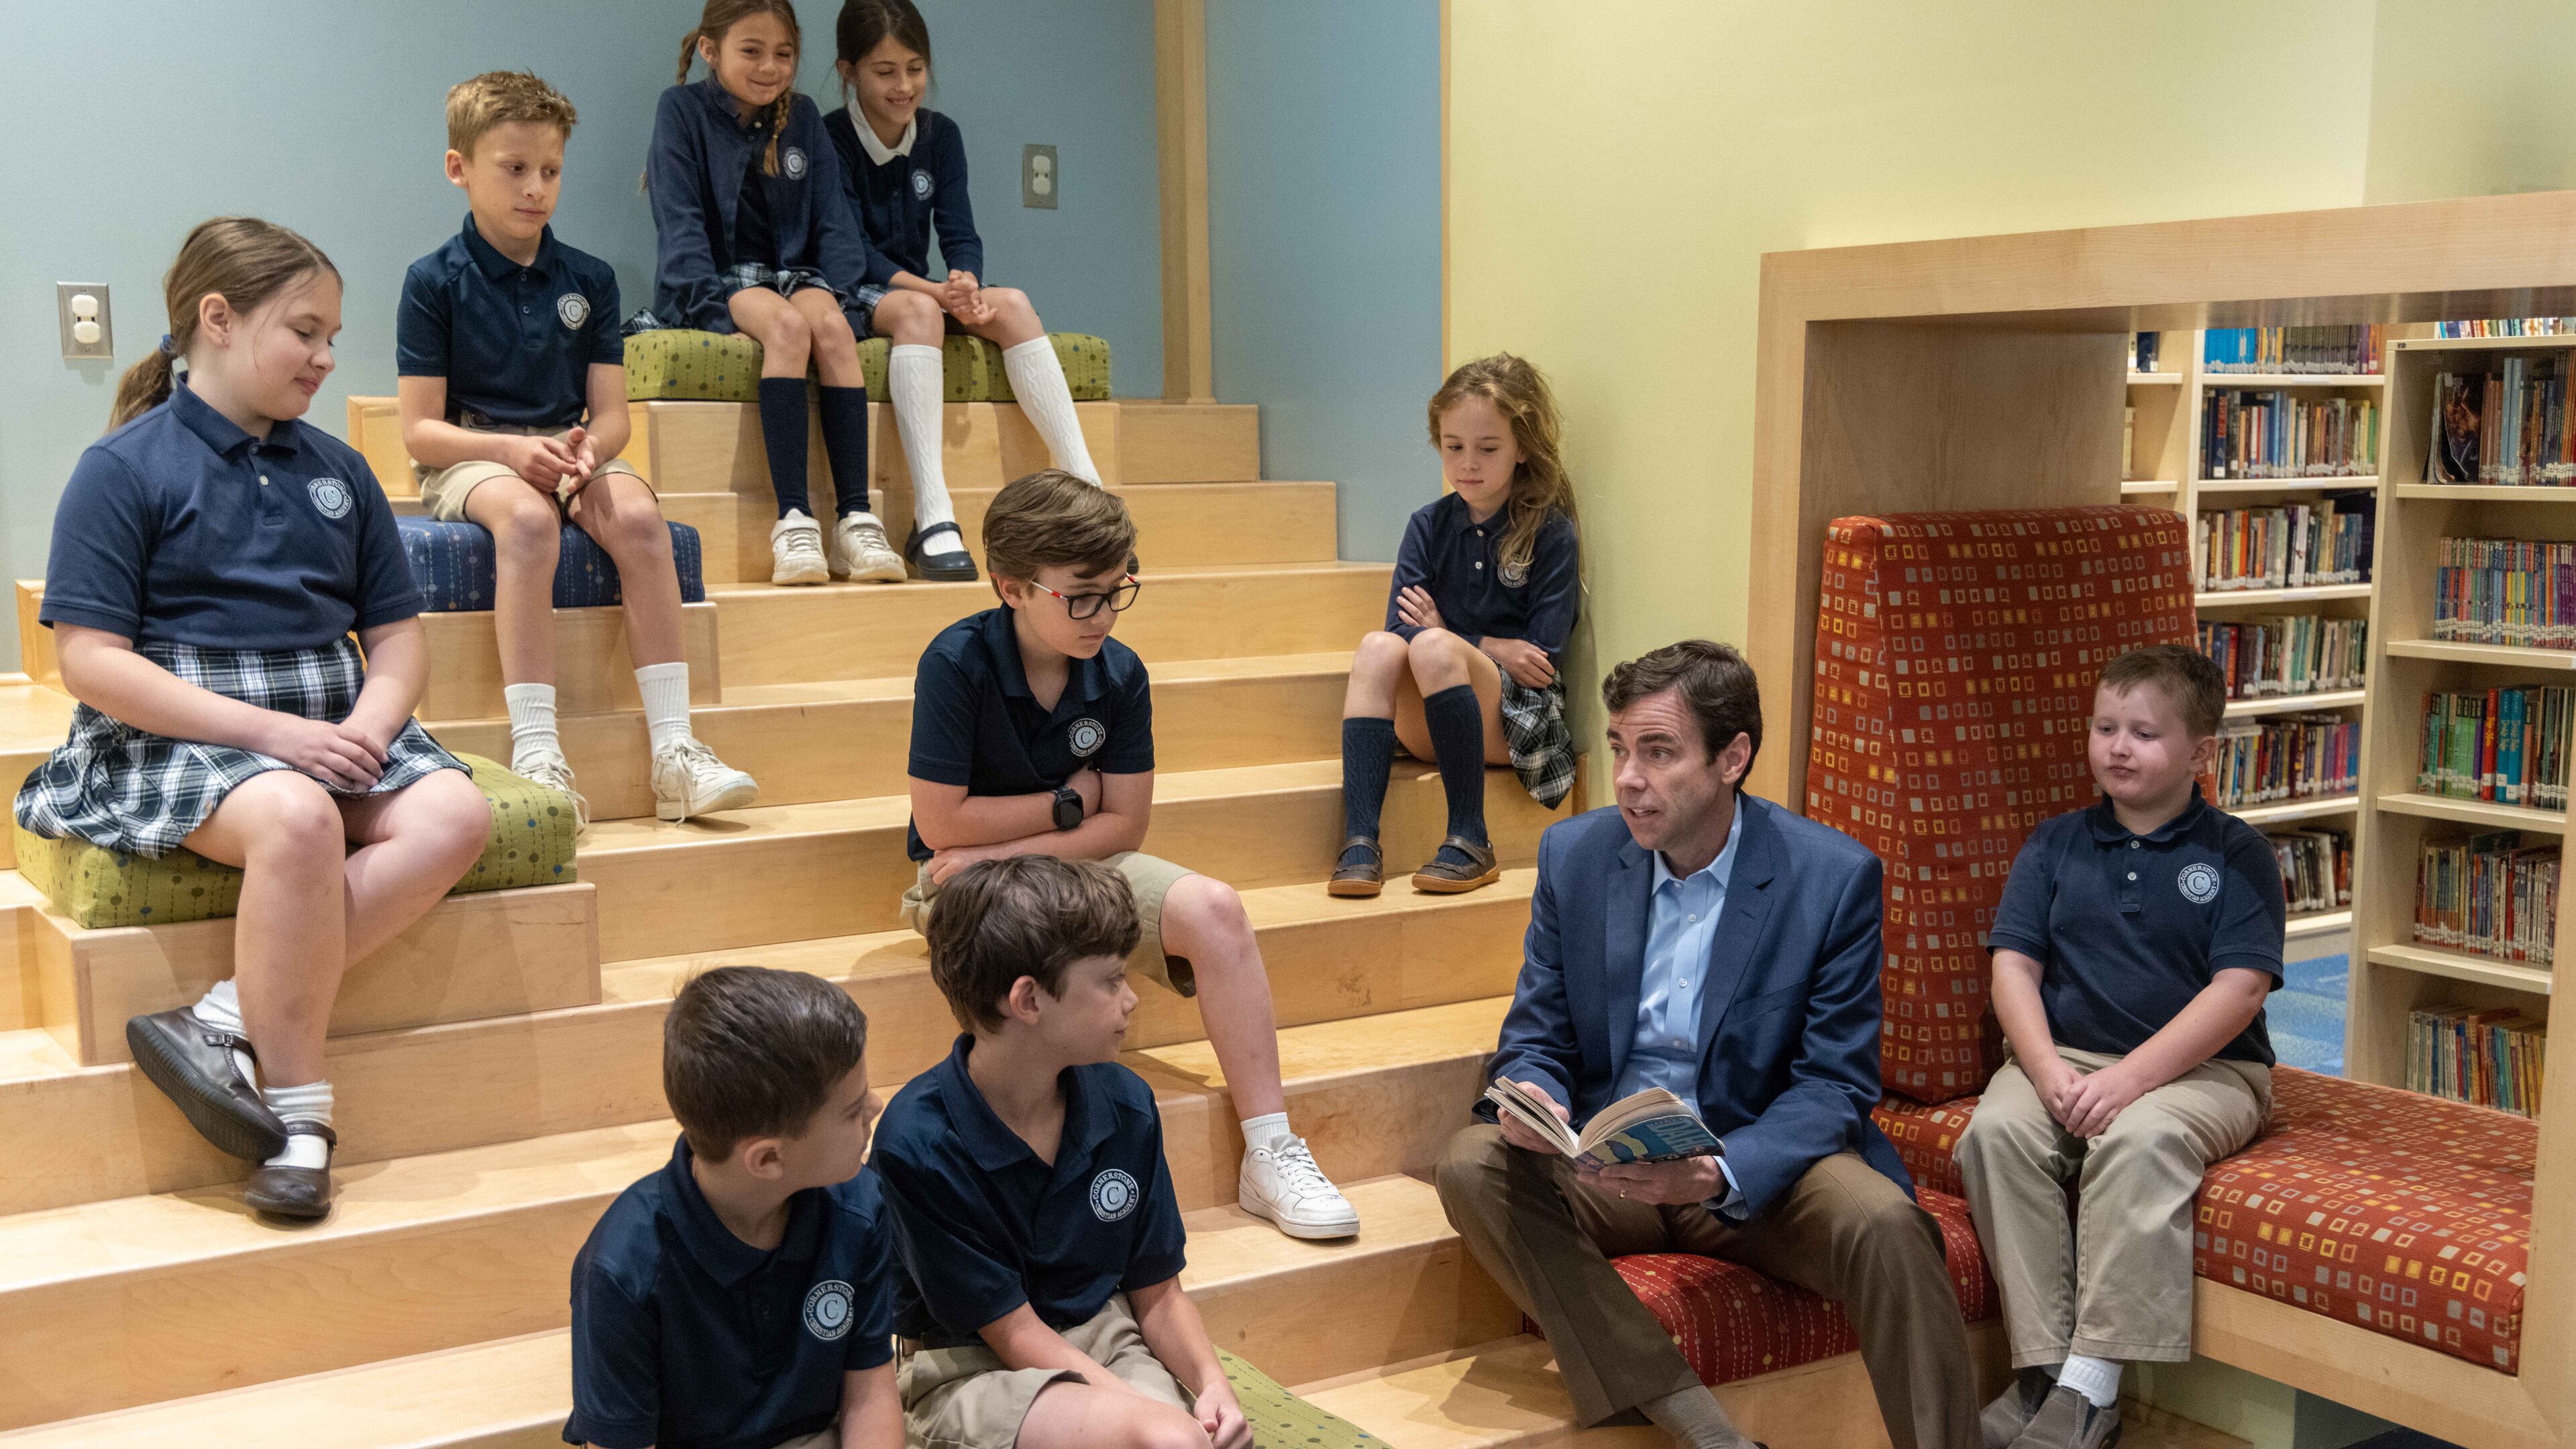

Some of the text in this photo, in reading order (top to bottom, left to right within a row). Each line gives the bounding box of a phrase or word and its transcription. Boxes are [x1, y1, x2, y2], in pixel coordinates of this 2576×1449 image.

[323, 490, 335, 504] C
[1069, 720, 1103, 739] CORNERSTONE
[1081, 731, 1091, 744] C
[2180, 865, 2216, 882] CORNERSTONE
[2193, 875, 2204, 890] C
[2181, 883, 2216, 902] CHRISTIAN ACADEMY
[1093, 1172, 1135, 1199] CORNERSTONE
[1107, 1185, 1120, 1205] C
[1095, 1193, 1136, 1219] CHRISTIAN ACADEMY
[824, 1299, 839, 1320] C
[808, 1317, 837, 1337] CHRISTIAN
